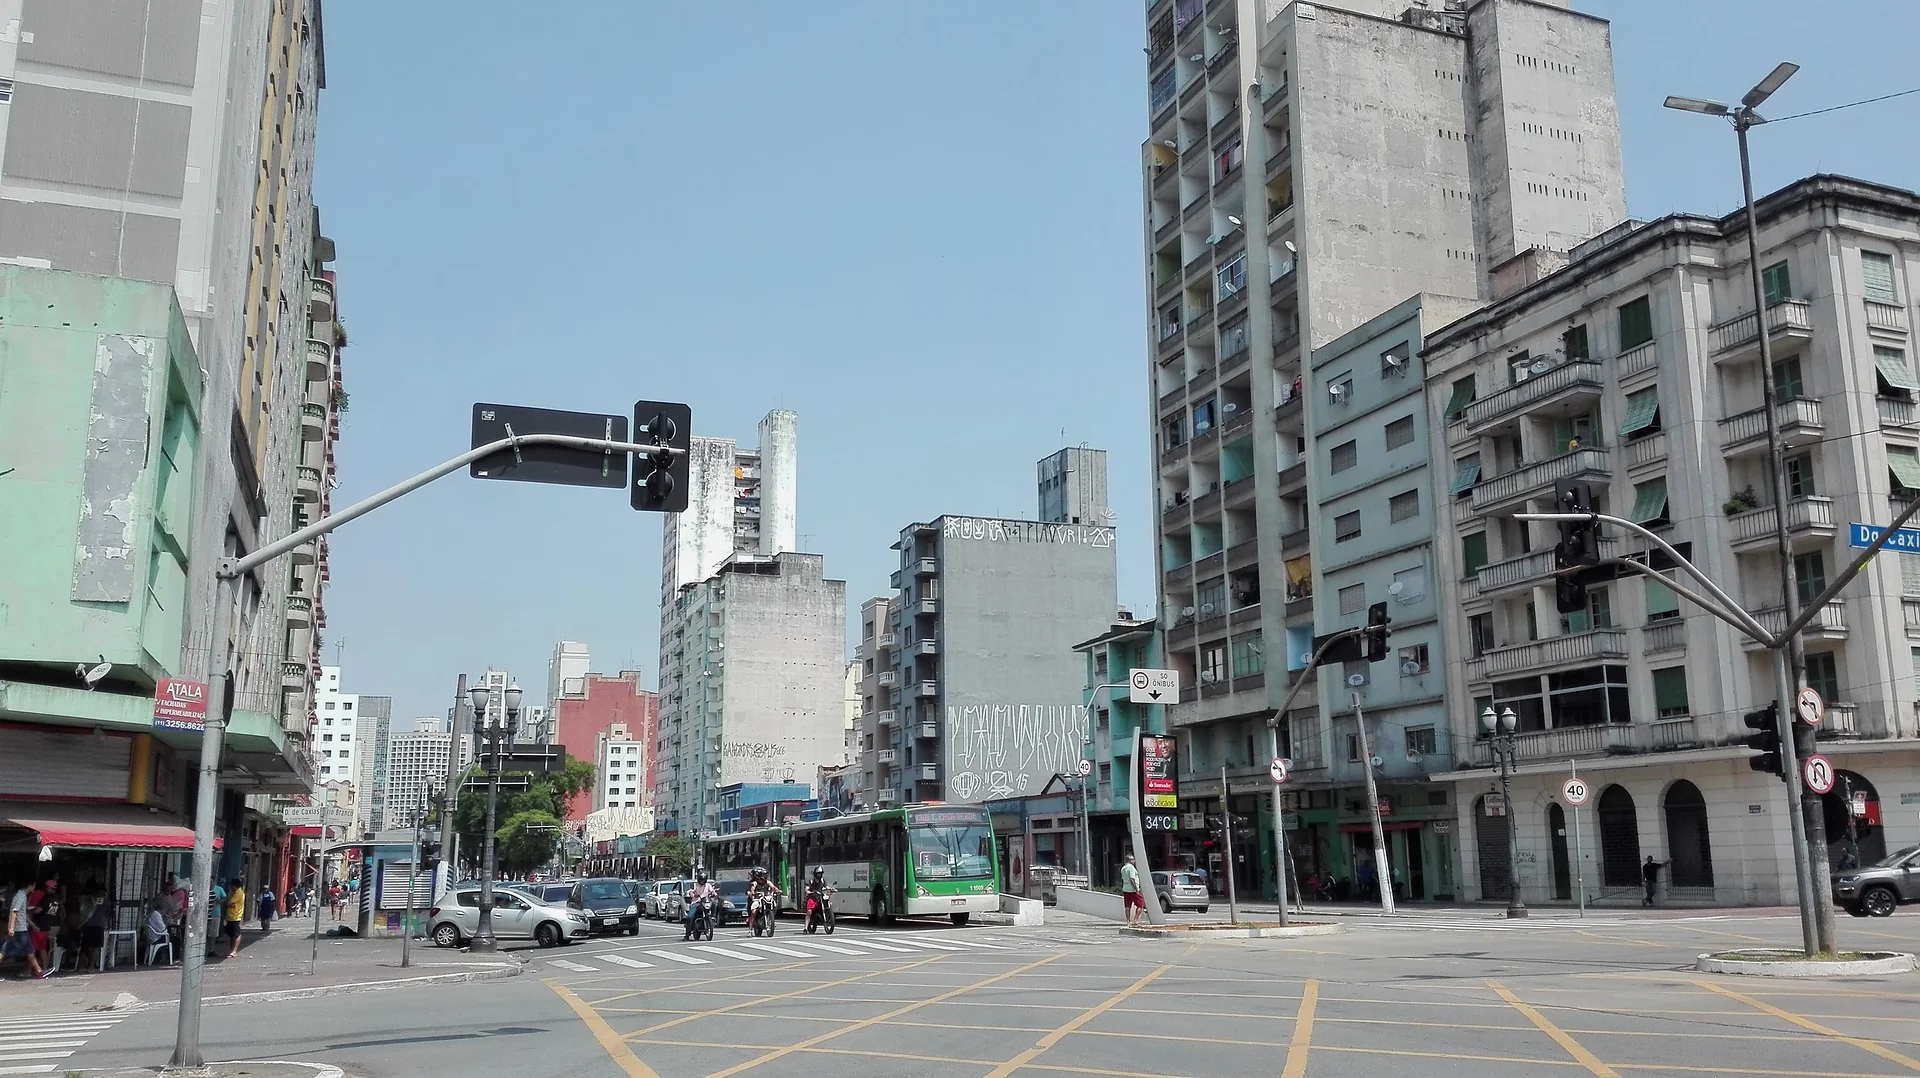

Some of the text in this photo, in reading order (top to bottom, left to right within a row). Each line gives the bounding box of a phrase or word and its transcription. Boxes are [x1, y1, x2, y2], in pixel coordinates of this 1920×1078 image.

[1159, 670, 1168, 680] SÓ
[1152, 678, 1175, 688] ÔNIBUS
[166, 682, 203, 699] ATALA
[160, 699, 187, 709] FACHADAS
[1080, 763, 1089, 771] 40
[1153, 781, 1171, 789] Santander
[1567, 784, 1584, 796] 40
[291, 807, 299, 815] de
[301, 805, 320, 815] Caxias
[335, 808, 354, 817] Branco
[956, 811, 977, 820] VERDE
[1145, 815, 1172, 830] 34°C
